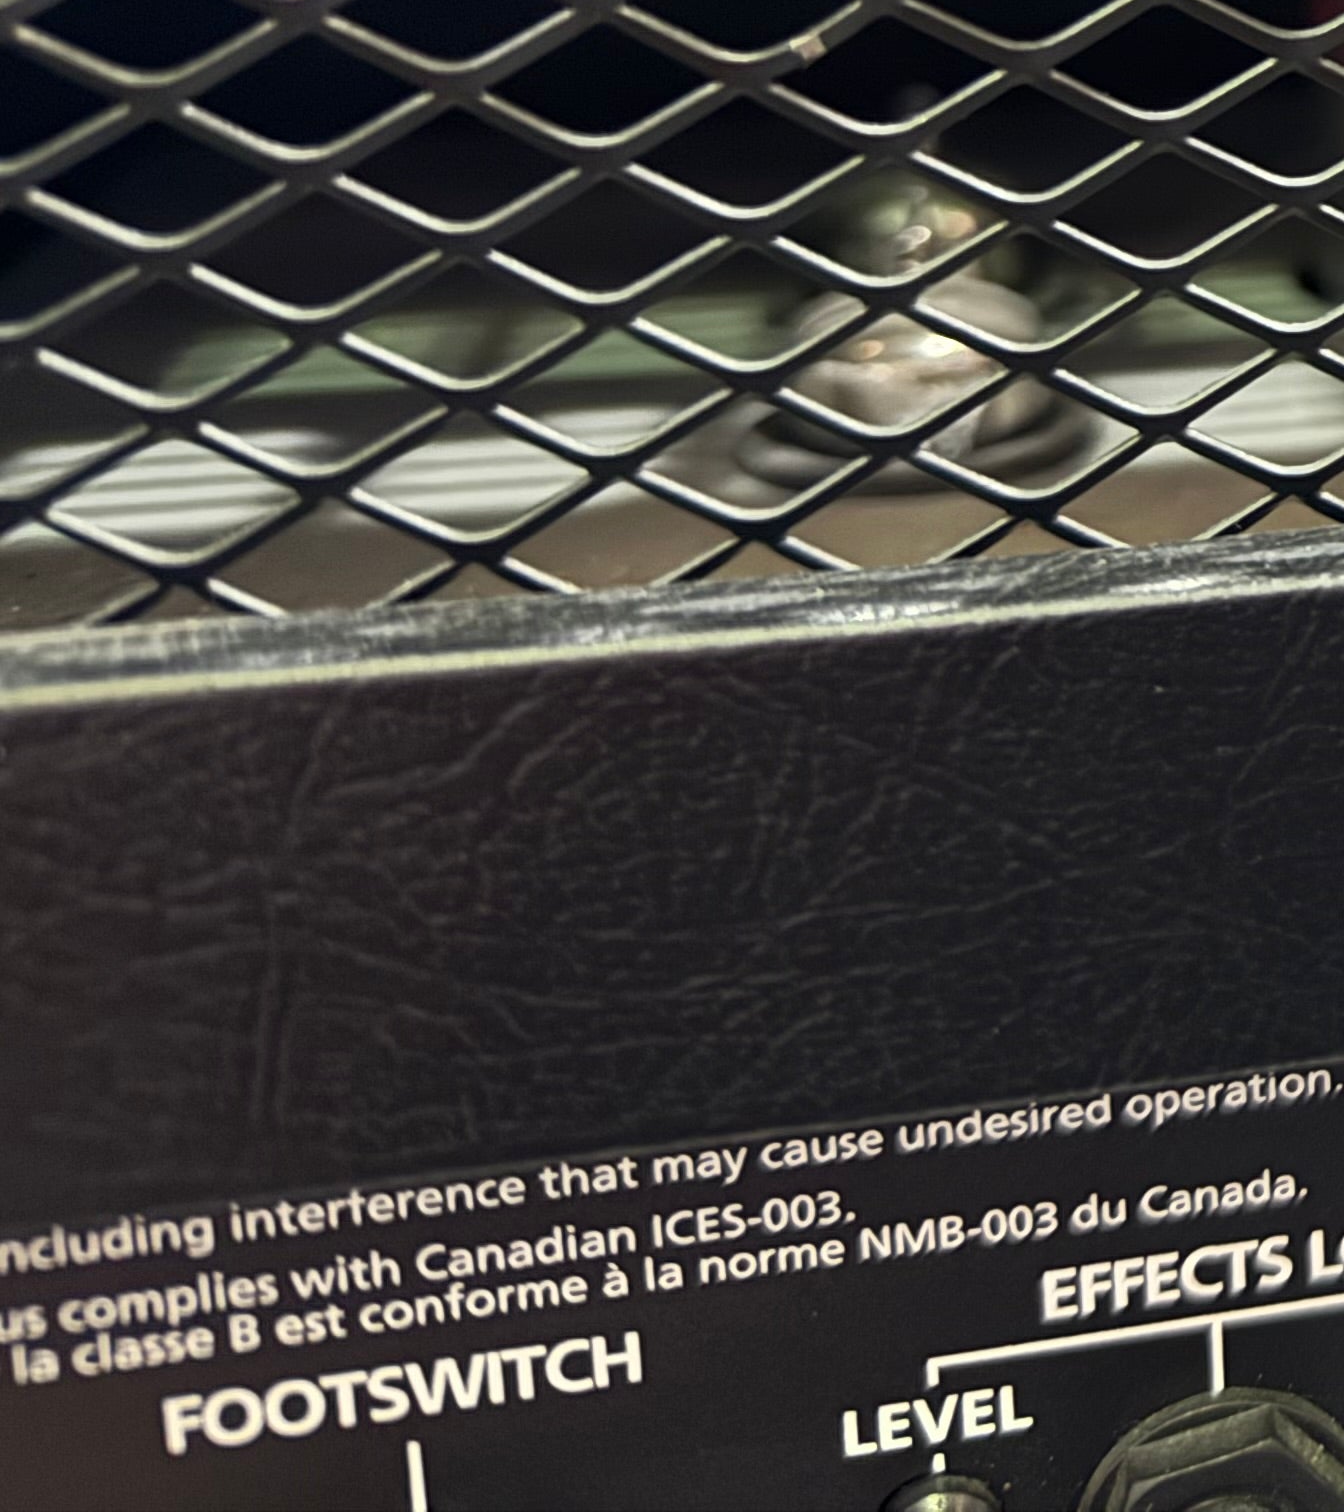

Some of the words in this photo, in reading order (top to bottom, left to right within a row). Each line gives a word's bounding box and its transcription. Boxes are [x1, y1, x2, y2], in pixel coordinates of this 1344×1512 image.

[230, 1174, 526, 1243] interference
[539, 1154, 640, 1201] that
[652, 1143, 748, 1186] may
[760, 1126, 884, 1172] cause
[898, 1092, 1112, 1152] undesired
[11, 1343, 60, 1385] la
[70, 1326, 215, 1377] classe
[227, 1313, 261, 1354] B
[274, 1303, 347, 1346] est
[358, 1276, 589, 1333] conforme
[601, 1265, 630, 1300] à
[644, 1255, 684, 1292] la
[700, 1238, 845, 1285] norme
[858, 1202, 1059, 1262] NMB-003
[1069, 1194, 1128, 1235] du
[57, 1270, 279, 1334] complies
[289, 1249, 401, 1300] with
[415, 1219, 637, 1282] Canadian
[1040, 1234, 1294, 1324] EFFECTS
[161, 1331, 642, 1456] FOOTSWITCH
[841, 1385, 1034, 1458] LEVEL
